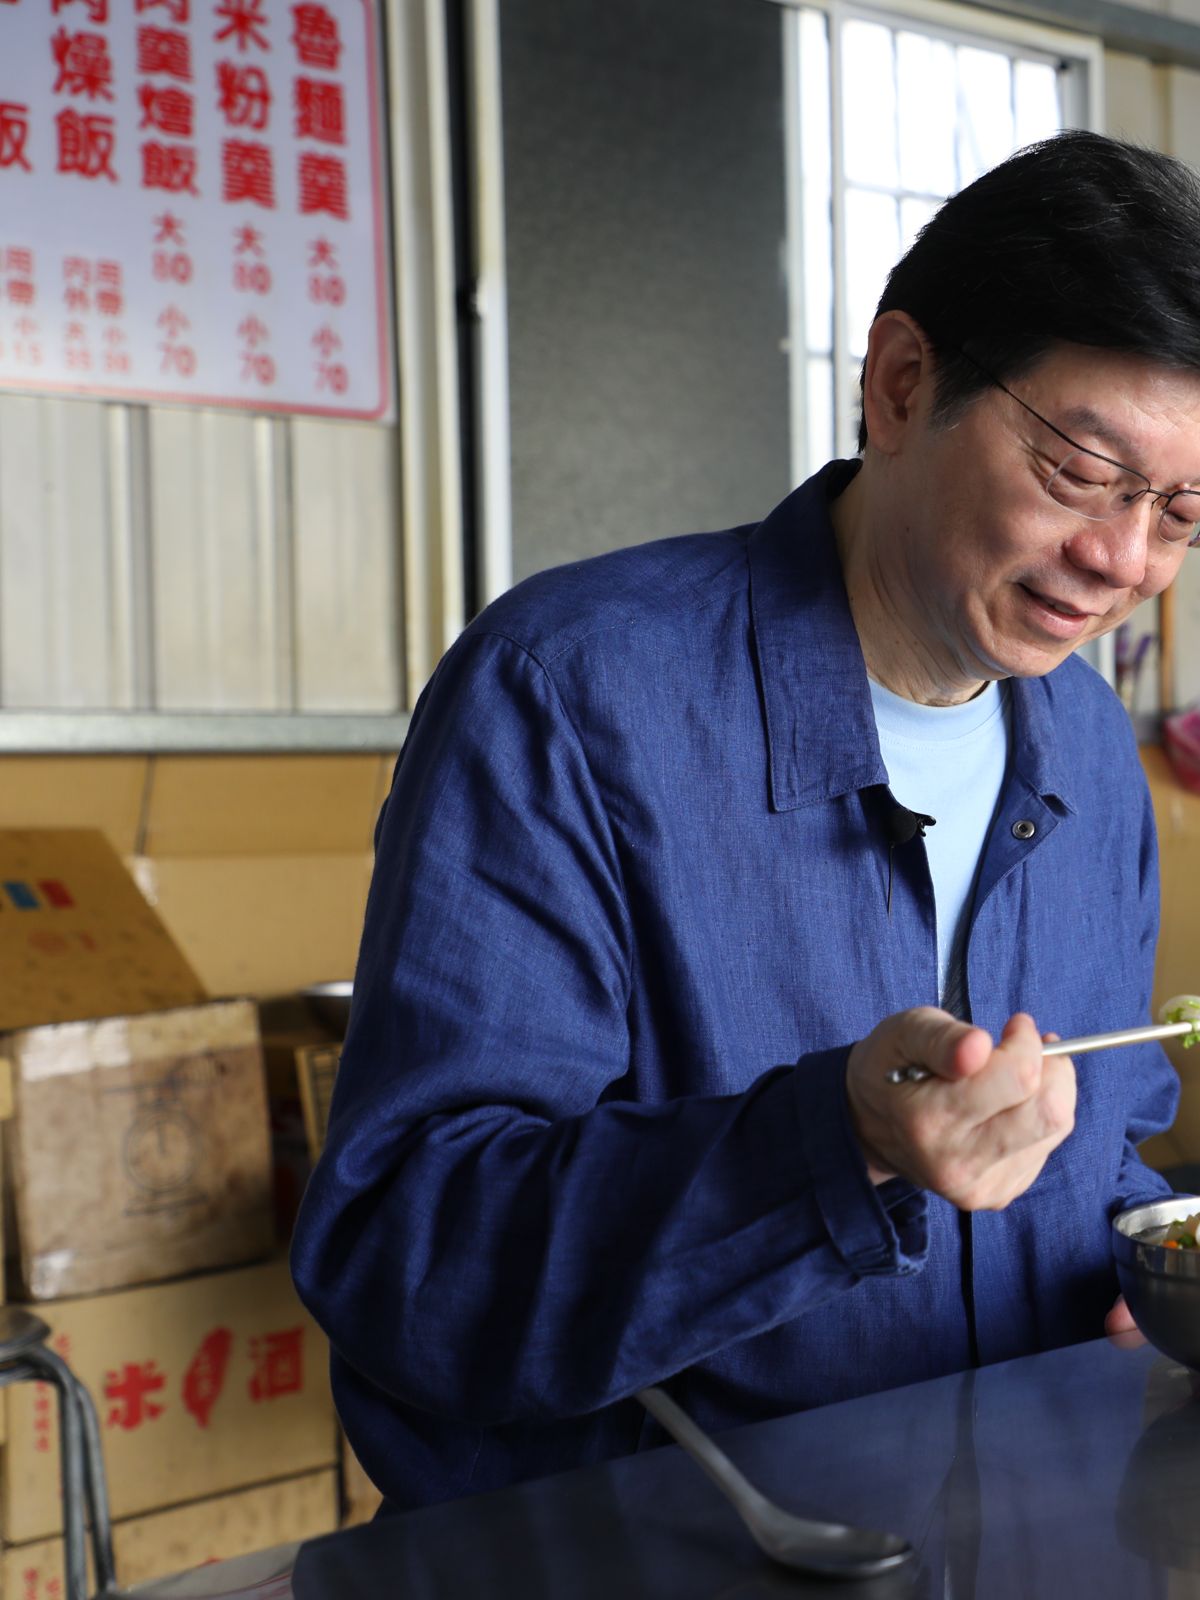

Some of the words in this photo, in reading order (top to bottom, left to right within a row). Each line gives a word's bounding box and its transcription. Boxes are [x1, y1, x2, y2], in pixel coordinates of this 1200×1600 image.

[213, 0, 277, 210] 米粉羹
[290, 1, 350, 222] 魯麵羹
